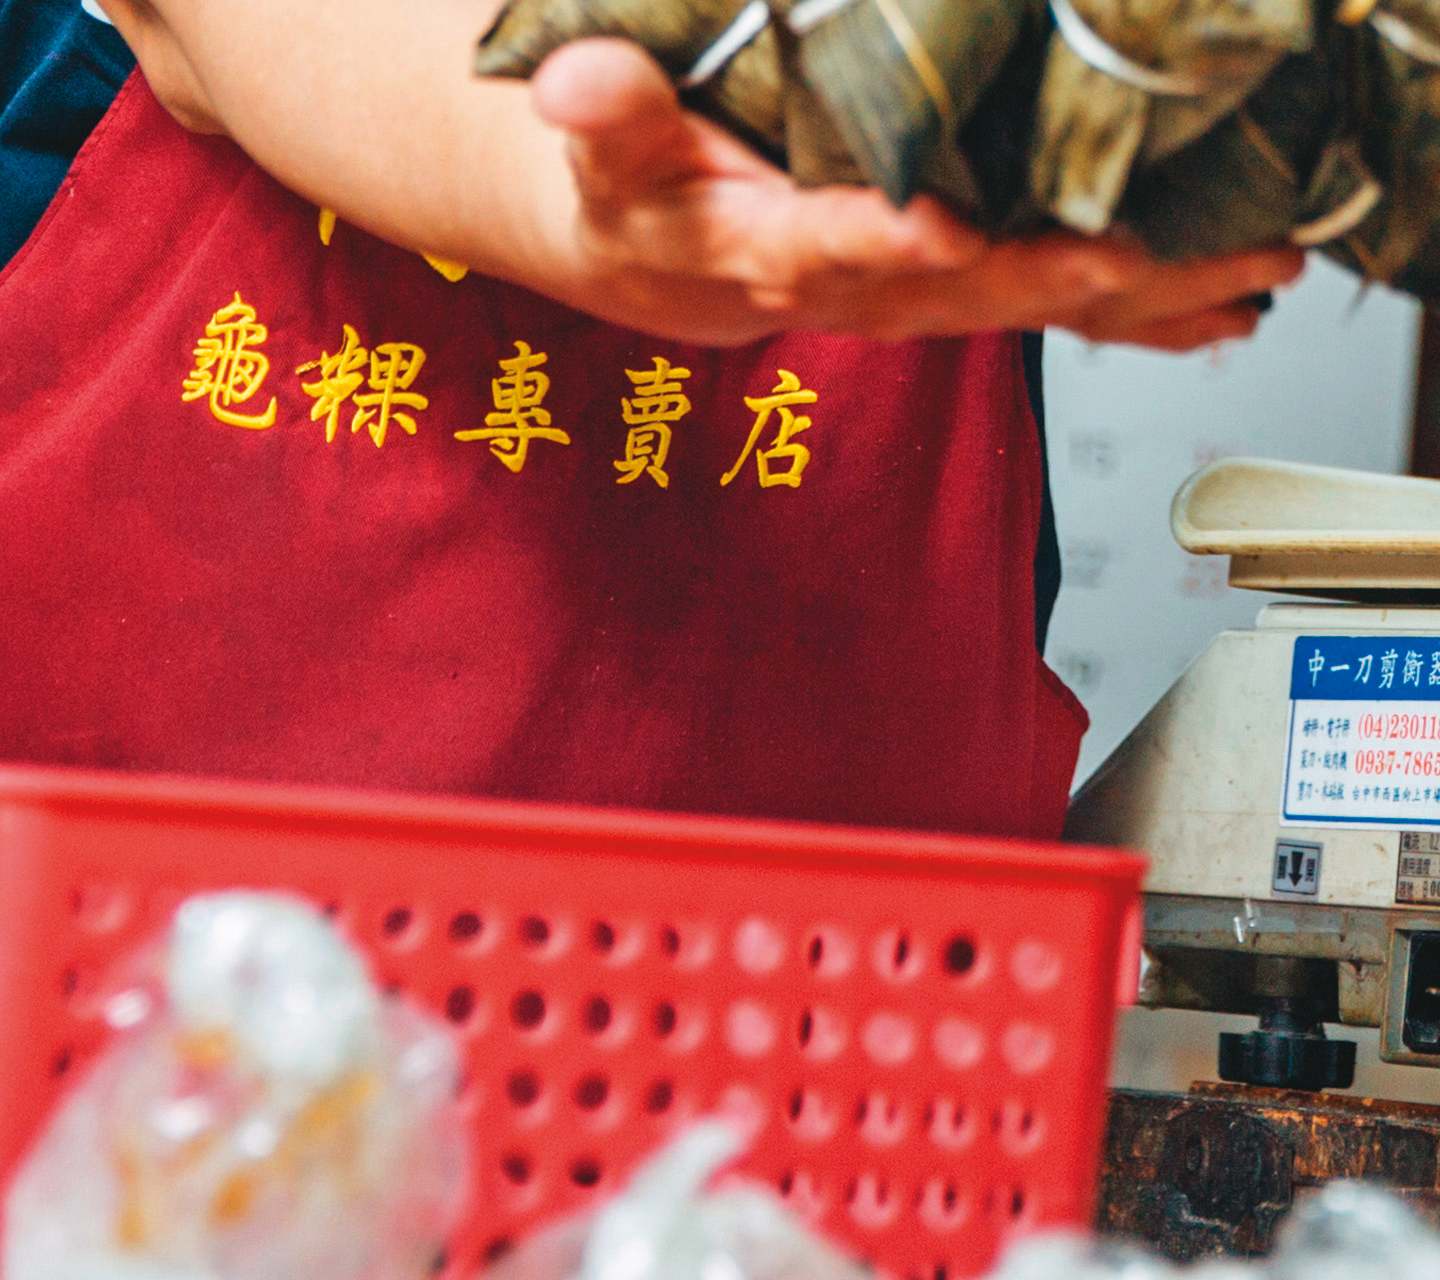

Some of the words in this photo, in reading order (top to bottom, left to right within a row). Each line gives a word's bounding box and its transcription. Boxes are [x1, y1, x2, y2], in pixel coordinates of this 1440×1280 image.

[181, 290, 819, 489] 龜粿專賣店
